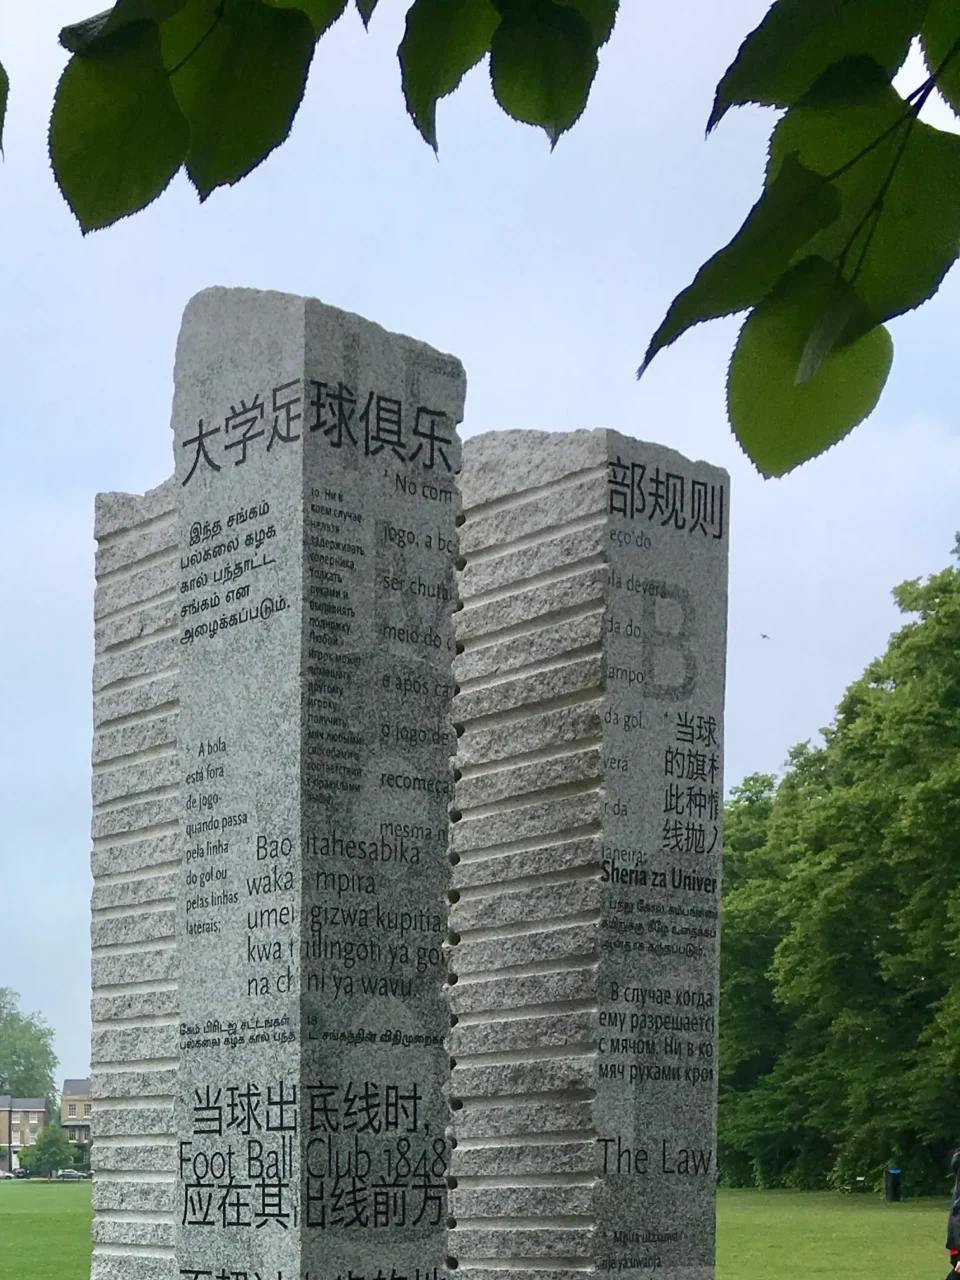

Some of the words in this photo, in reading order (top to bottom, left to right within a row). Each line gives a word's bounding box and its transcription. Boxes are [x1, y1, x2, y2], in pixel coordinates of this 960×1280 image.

[395, 473, 417, 496] No
[608, 455, 724, 540] 部规则
[636, 530, 651, 549] do
[626, 618, 640, 637] do
[186, 816, 219, 837] quando
[222, 812, 247, 832] passa
[380, 823, 432, 840] mesma
[256, 835, 292, 860] Bao
[246, 866, 293, 896] waka
[316, 869, 376, 898] mpira
[248, 936, 281, 962] kwa
[390, 945, 408, 970] ya
[248, 976, 269, 996] na
[333, 975, 353, 1000] ya
[624, 986, 671, 1009] случае
[676, 990, 712, 1009] когда
[599, 1010, 626, 1032] ему
[599, 1063, 625, 1079] мяч
[630, 1064, 680, 1085] руками
[180, 1141, 235, 1179] Foot
[247, 1135, 292, 1179] Ball
[307, 1135, 371, 1179] Club
[384, 1138, 447, 1179] 1848
[597, 1136, 648, 1175] The
[662, 1139, 712, 1175] Law
